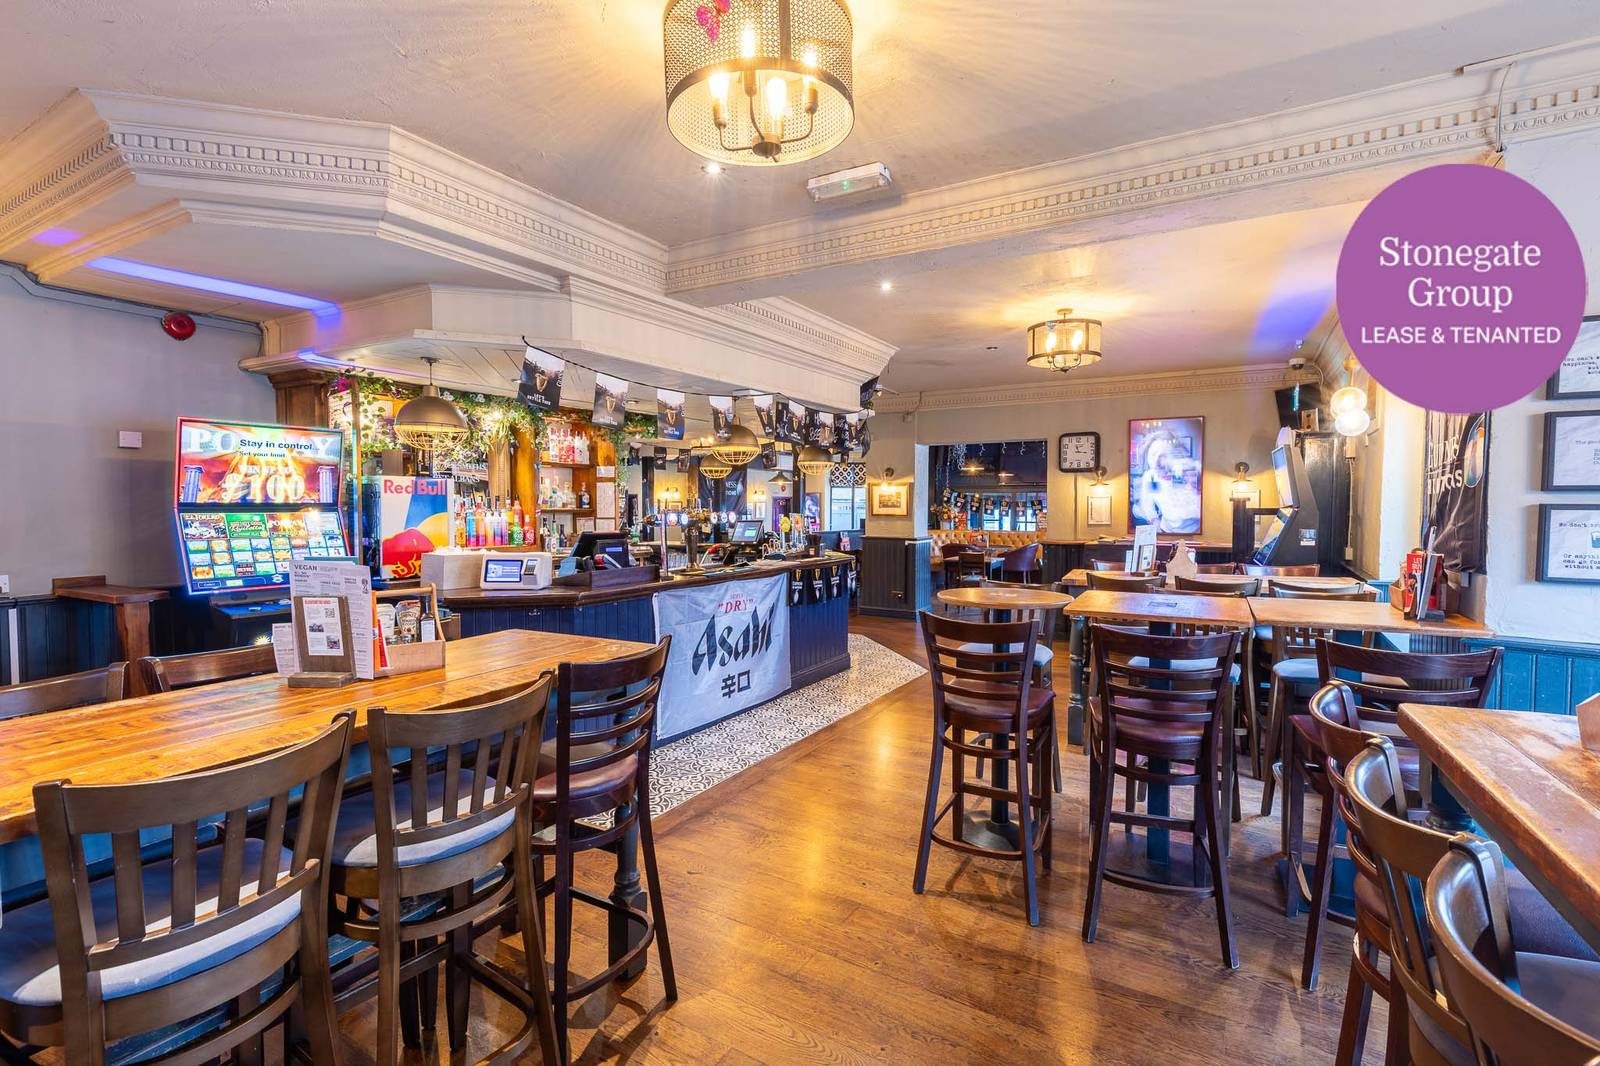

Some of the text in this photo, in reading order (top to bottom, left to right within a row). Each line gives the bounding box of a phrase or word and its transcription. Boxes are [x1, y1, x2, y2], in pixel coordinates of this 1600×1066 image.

[239, 439, 263, 448] Stay
[252, 451, 269, 459] your
[383, 479, 414, 495] Red
[417, 479, 447, 496] Bull
[691, 602, 776, 676] Asahi
[721, 669, 752, 699] 辛口
